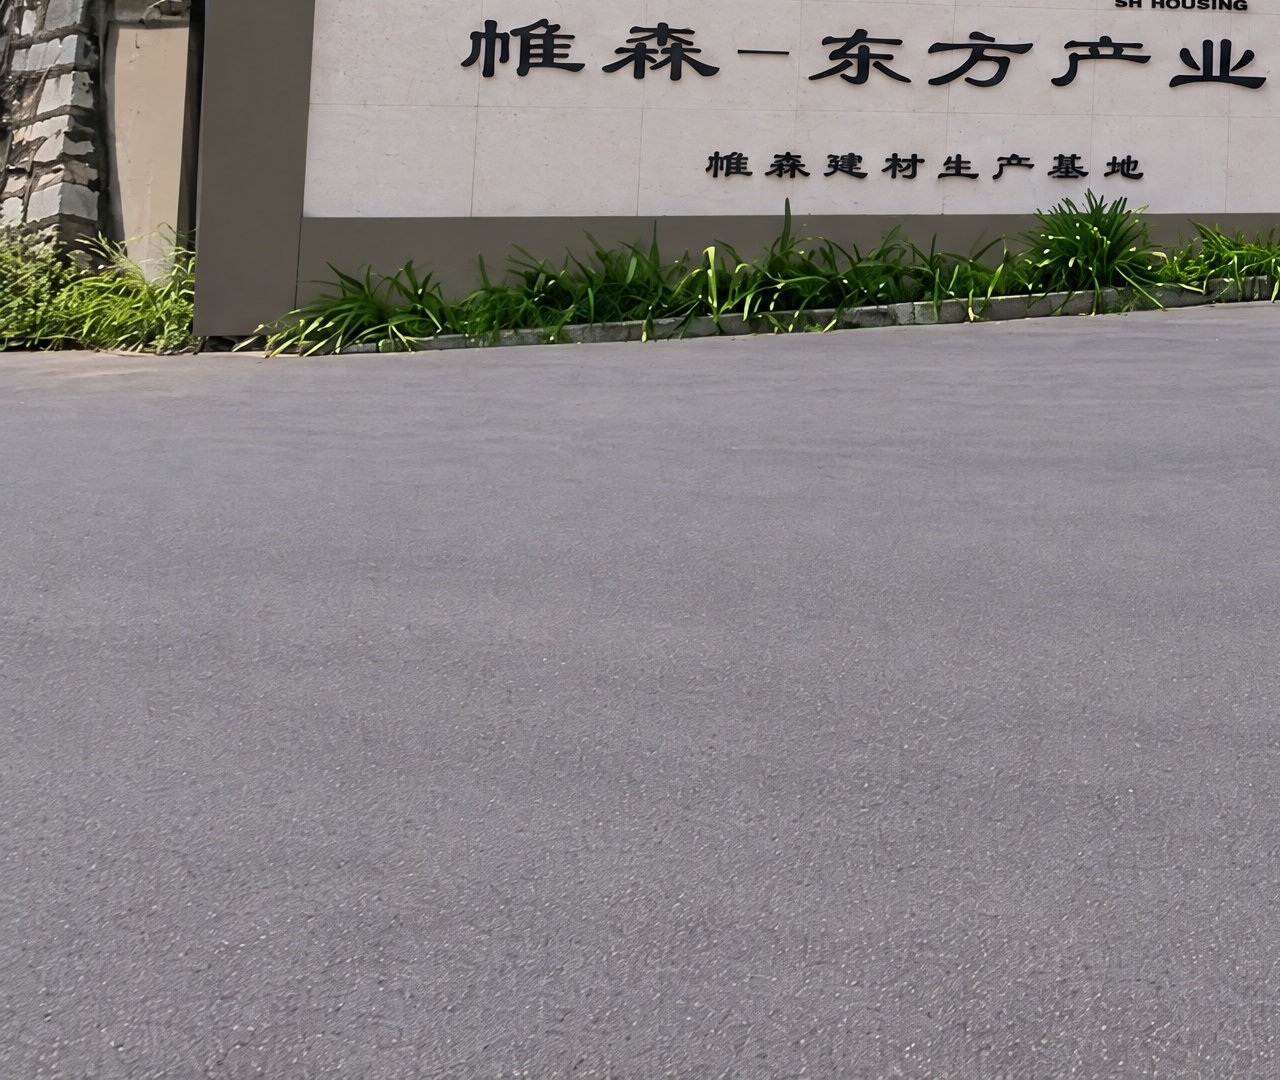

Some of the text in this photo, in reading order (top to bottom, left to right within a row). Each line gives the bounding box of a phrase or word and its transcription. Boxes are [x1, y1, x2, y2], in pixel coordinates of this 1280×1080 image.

[705, 151, 1144, 180] 帷森建材生产基地
